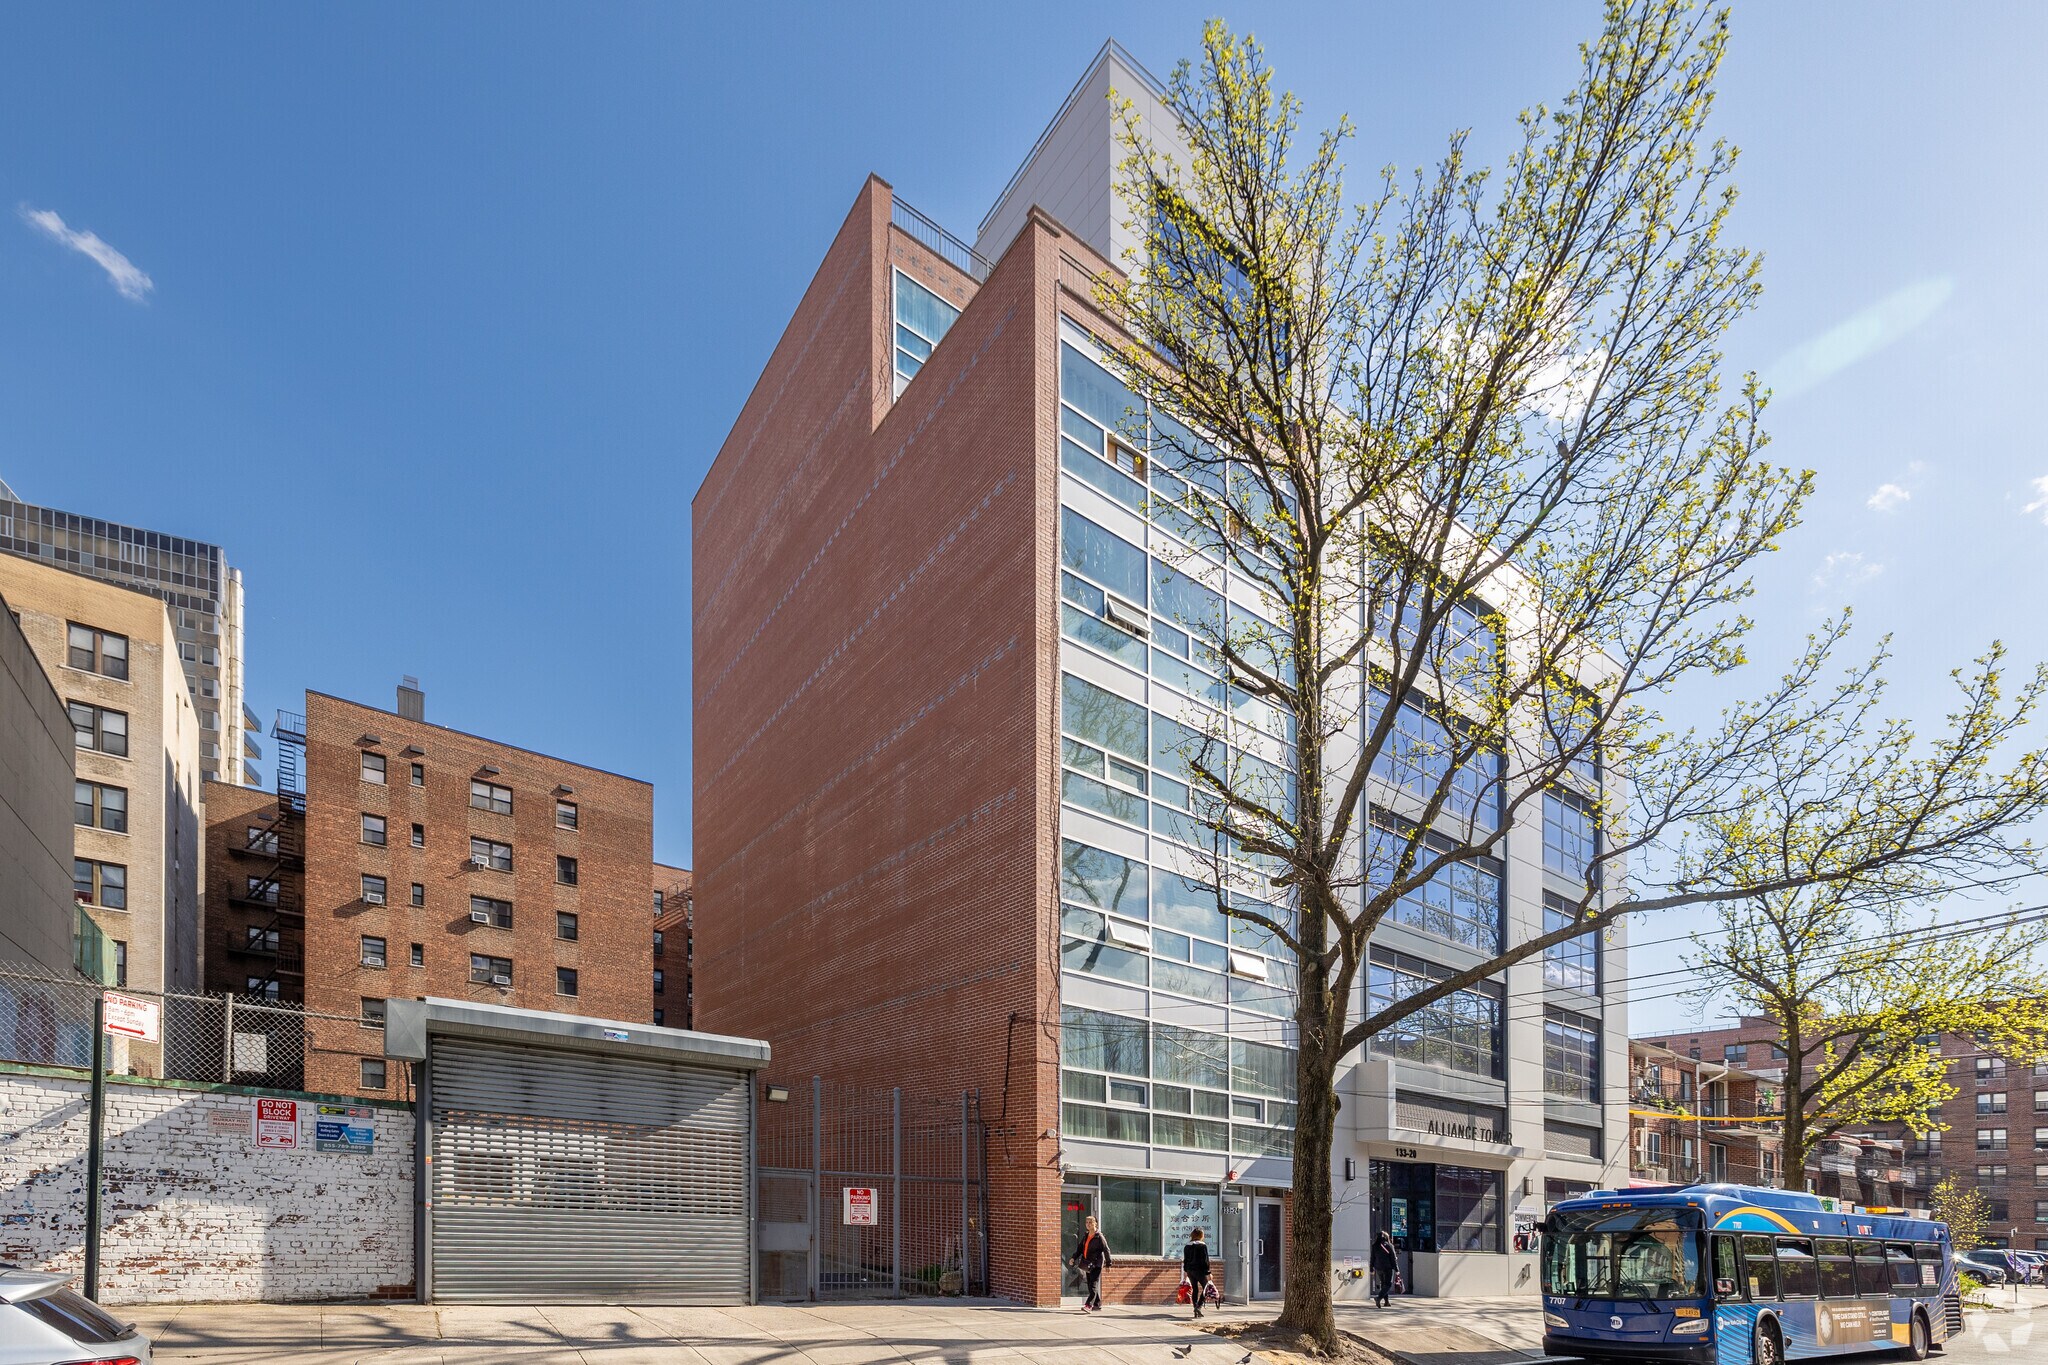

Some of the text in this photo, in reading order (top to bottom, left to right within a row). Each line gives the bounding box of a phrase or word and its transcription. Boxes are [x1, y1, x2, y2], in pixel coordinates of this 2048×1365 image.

[108, 996, 147, 1011] NO PARKING
[108, 1013, 126, 1022] Except
[1428, 1120, 1513, 1146] ALLIANCE TOWER
[1396, 1148, 1417, 1158] 133-20
